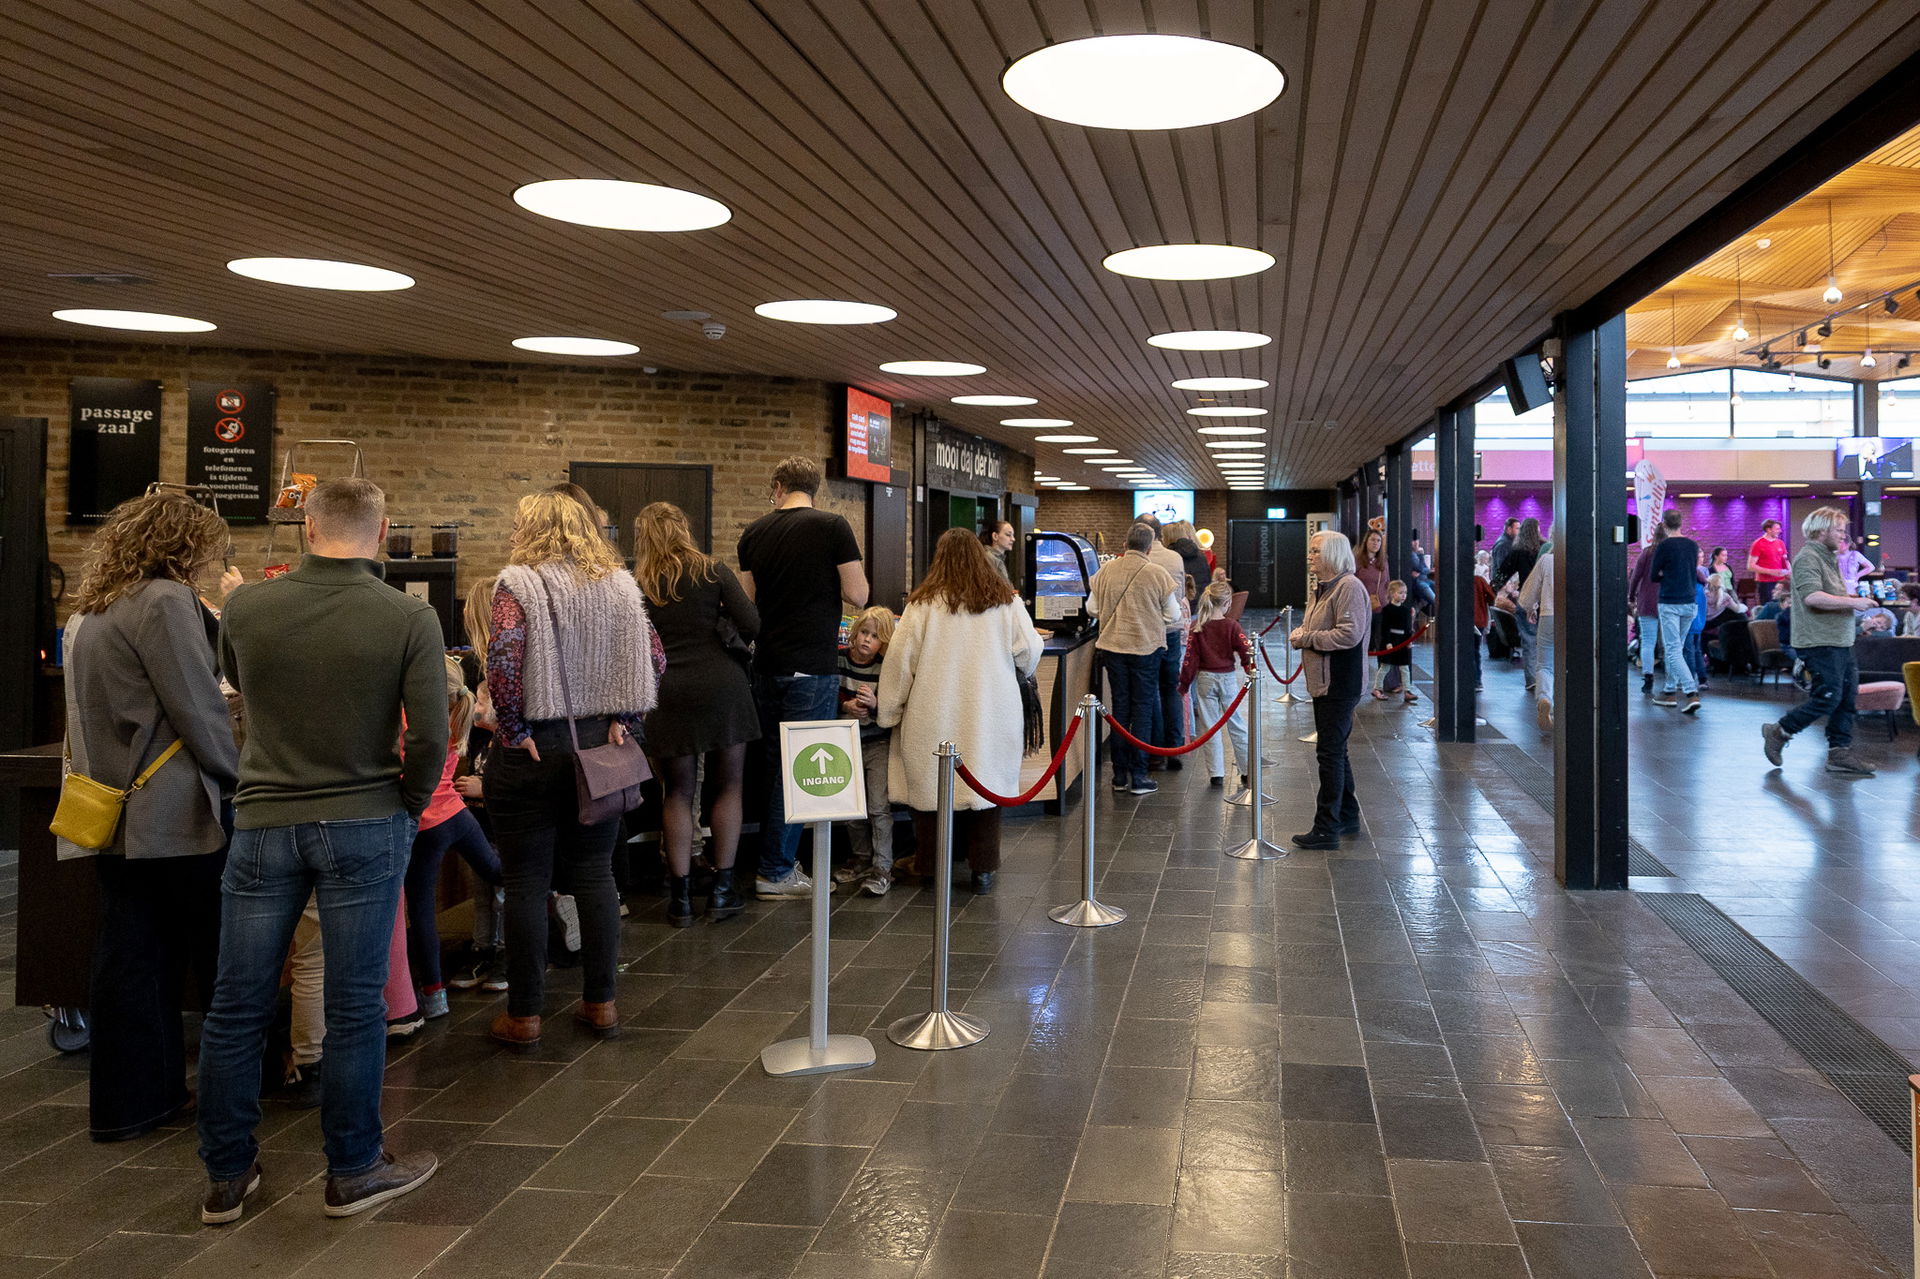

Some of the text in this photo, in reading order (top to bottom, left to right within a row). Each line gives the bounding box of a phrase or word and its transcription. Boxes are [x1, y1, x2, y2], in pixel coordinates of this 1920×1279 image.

[81, 407, 153, 422] passage
[98, 422, 136, 434] zaal
[203, 446, 255, 455] fotograferen
[936, 441, 959, 470] mooi
[960, 443, 973, 480] daj
[974, 448, 987, 476] der
[218, 474, 248, 482] tijdens
[803, 776, 844, 786] INGANG
